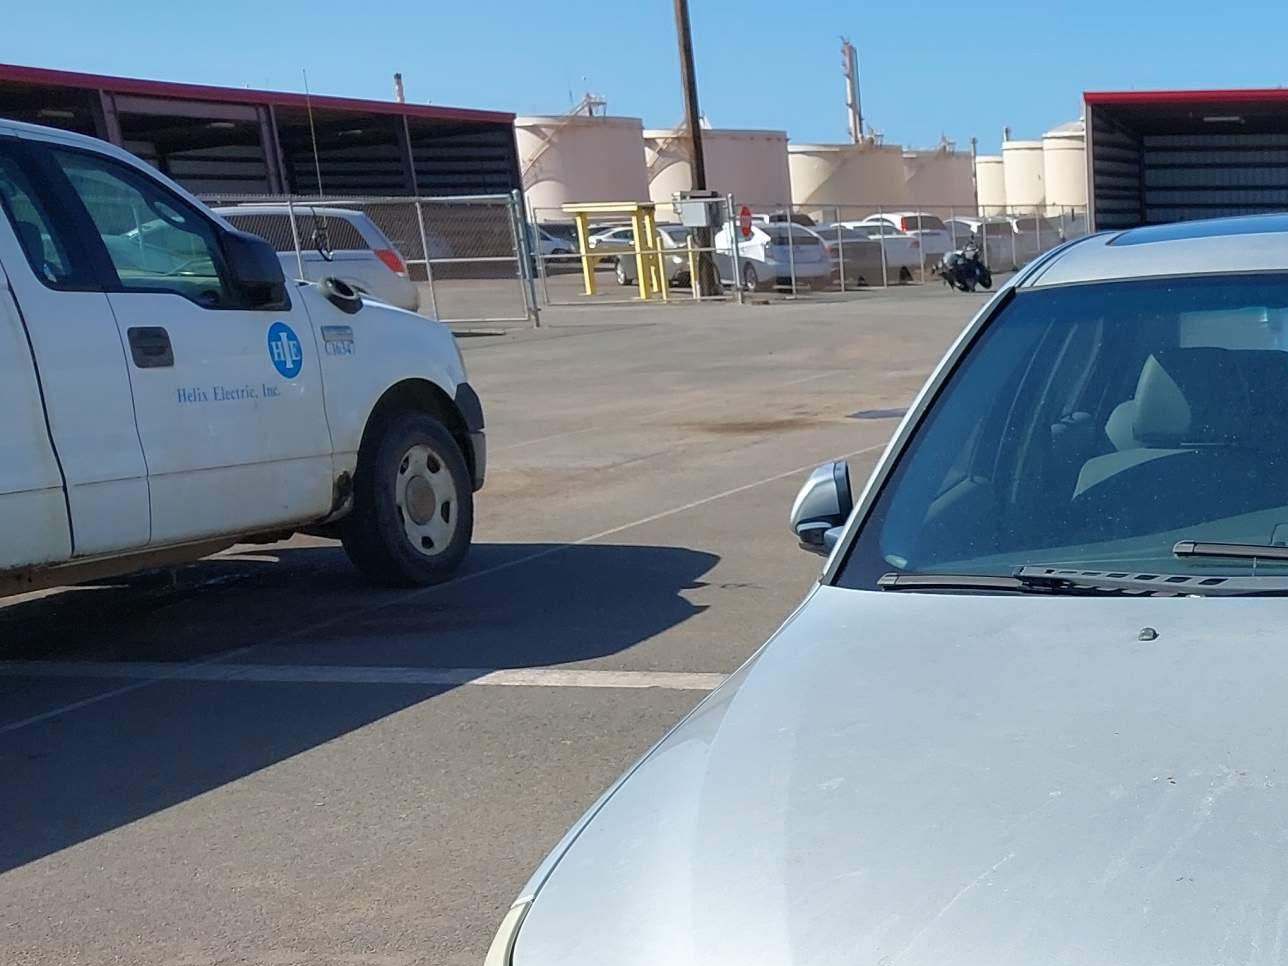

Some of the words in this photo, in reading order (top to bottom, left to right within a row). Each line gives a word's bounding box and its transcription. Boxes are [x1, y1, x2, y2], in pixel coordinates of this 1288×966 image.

[177, 387, 209, 403] Helix
[213, 384, 259, 402] Electric,
[262, 383, 281, 398] Inc.
